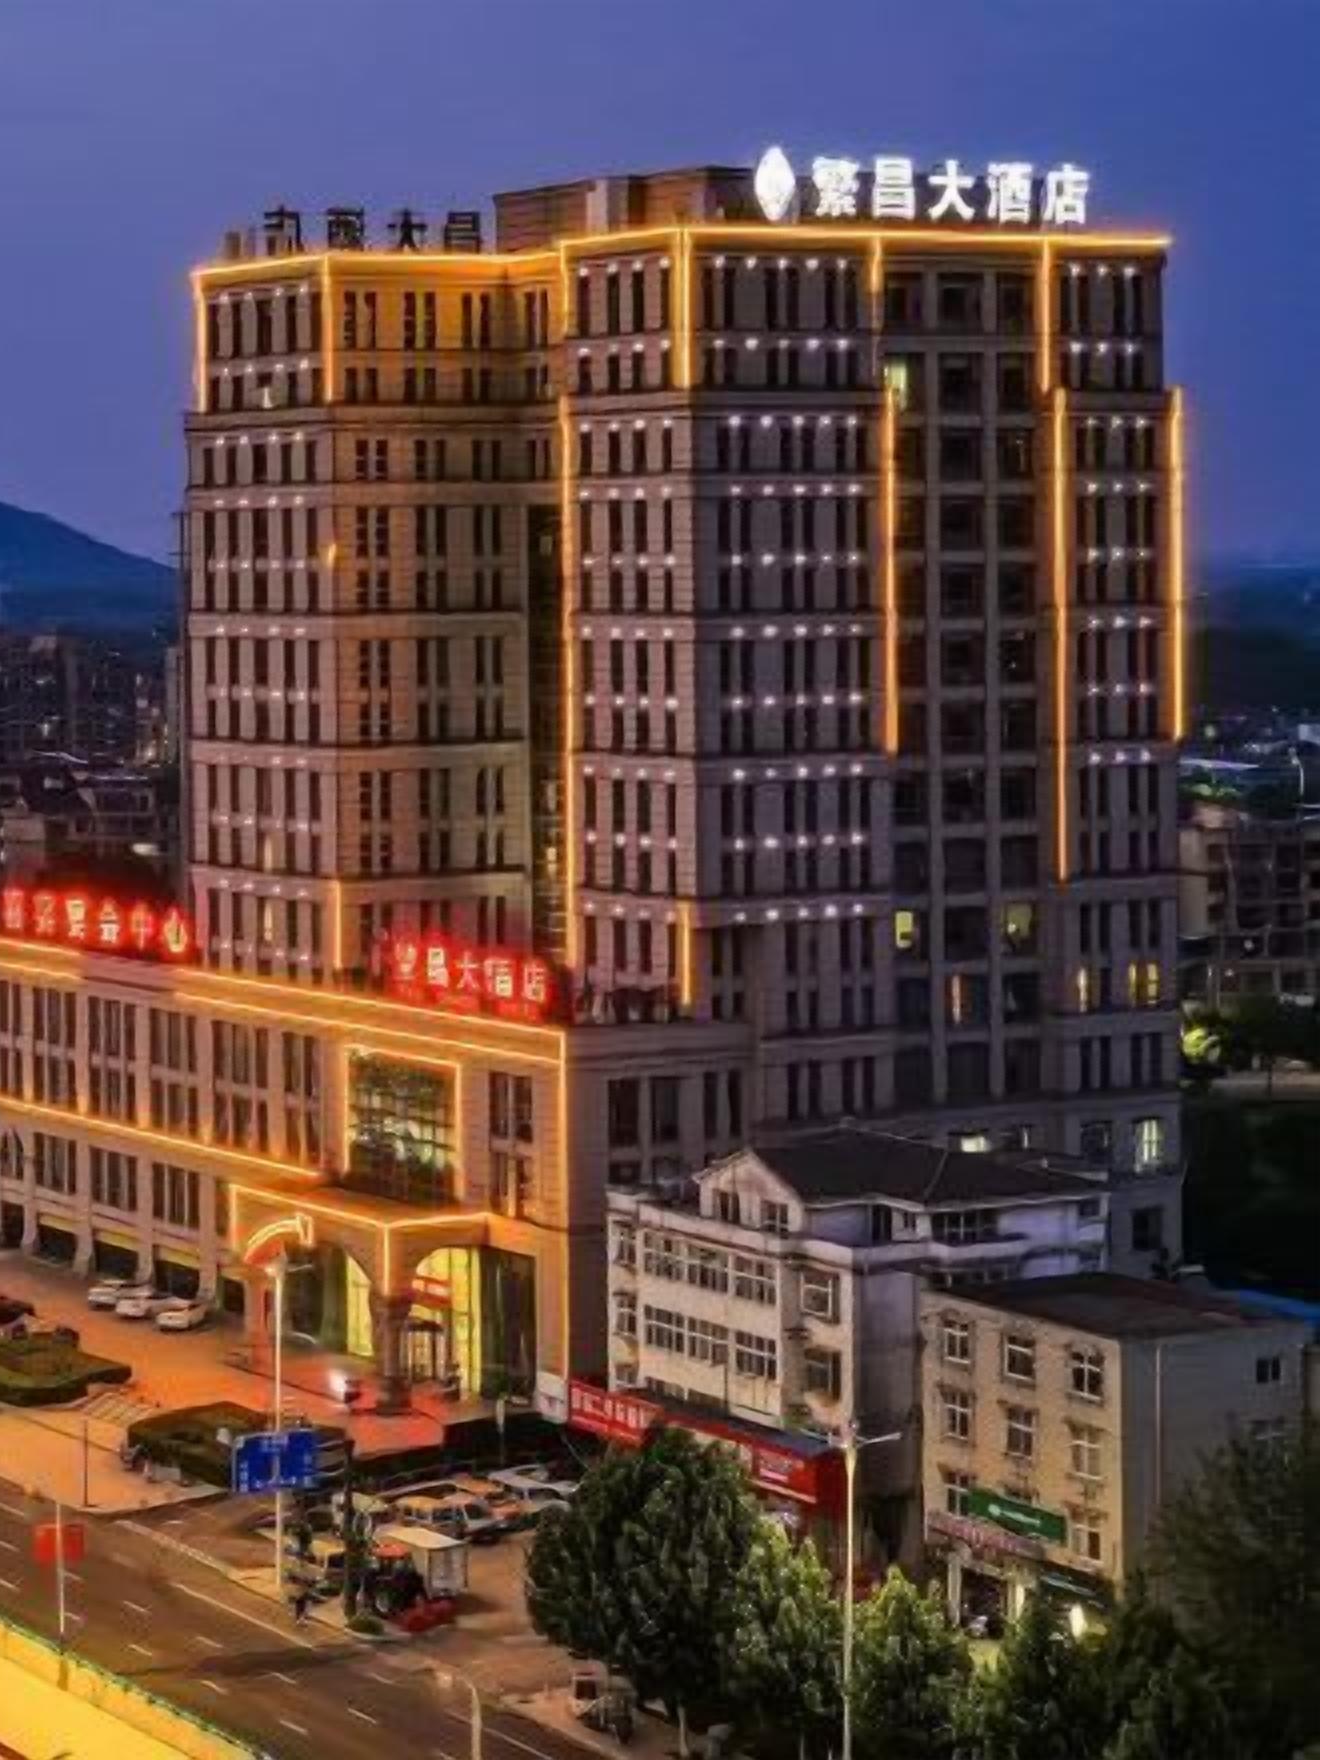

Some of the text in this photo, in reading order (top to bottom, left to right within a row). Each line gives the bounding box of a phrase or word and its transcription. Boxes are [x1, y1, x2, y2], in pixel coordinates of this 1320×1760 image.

[812, 156, 1090, 225] 繁昌大酒店
